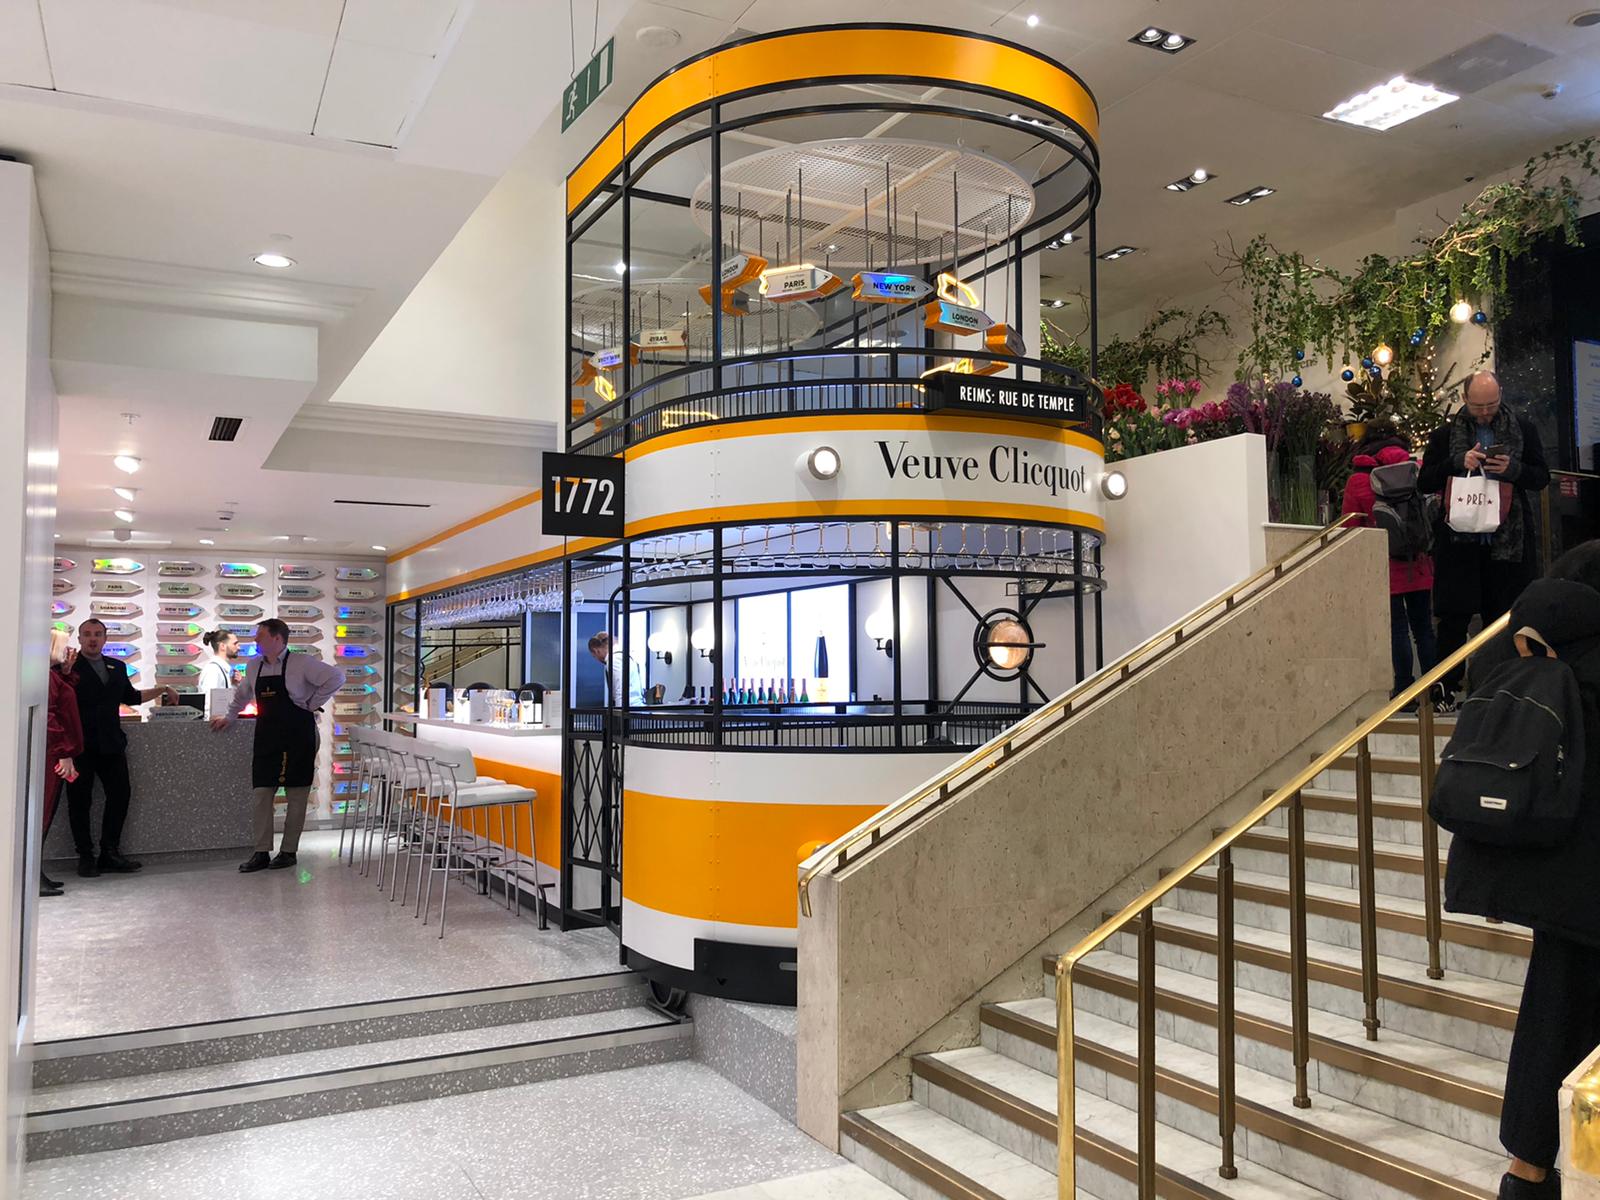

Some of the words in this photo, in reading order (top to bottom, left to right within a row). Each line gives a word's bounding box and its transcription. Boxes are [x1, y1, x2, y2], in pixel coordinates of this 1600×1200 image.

[784, 279, 805, 289] PARIS
[873, 282, 892, 290] NEW
[893, 283, 916, 292] YORK
[952, 312, 979, 325] LONDON
[959, 385, 995, 404] REIMS:
[999, 390, 1018, 407] RUE
[1022, 392, 1035, 408] DE
[1038, 394, 1075, 412] TEMPLE
[874, 440, 979, 481] Veuve
[989, 444, 1087, 496] Clicquot
[551, 475, 615, 516] 1772
